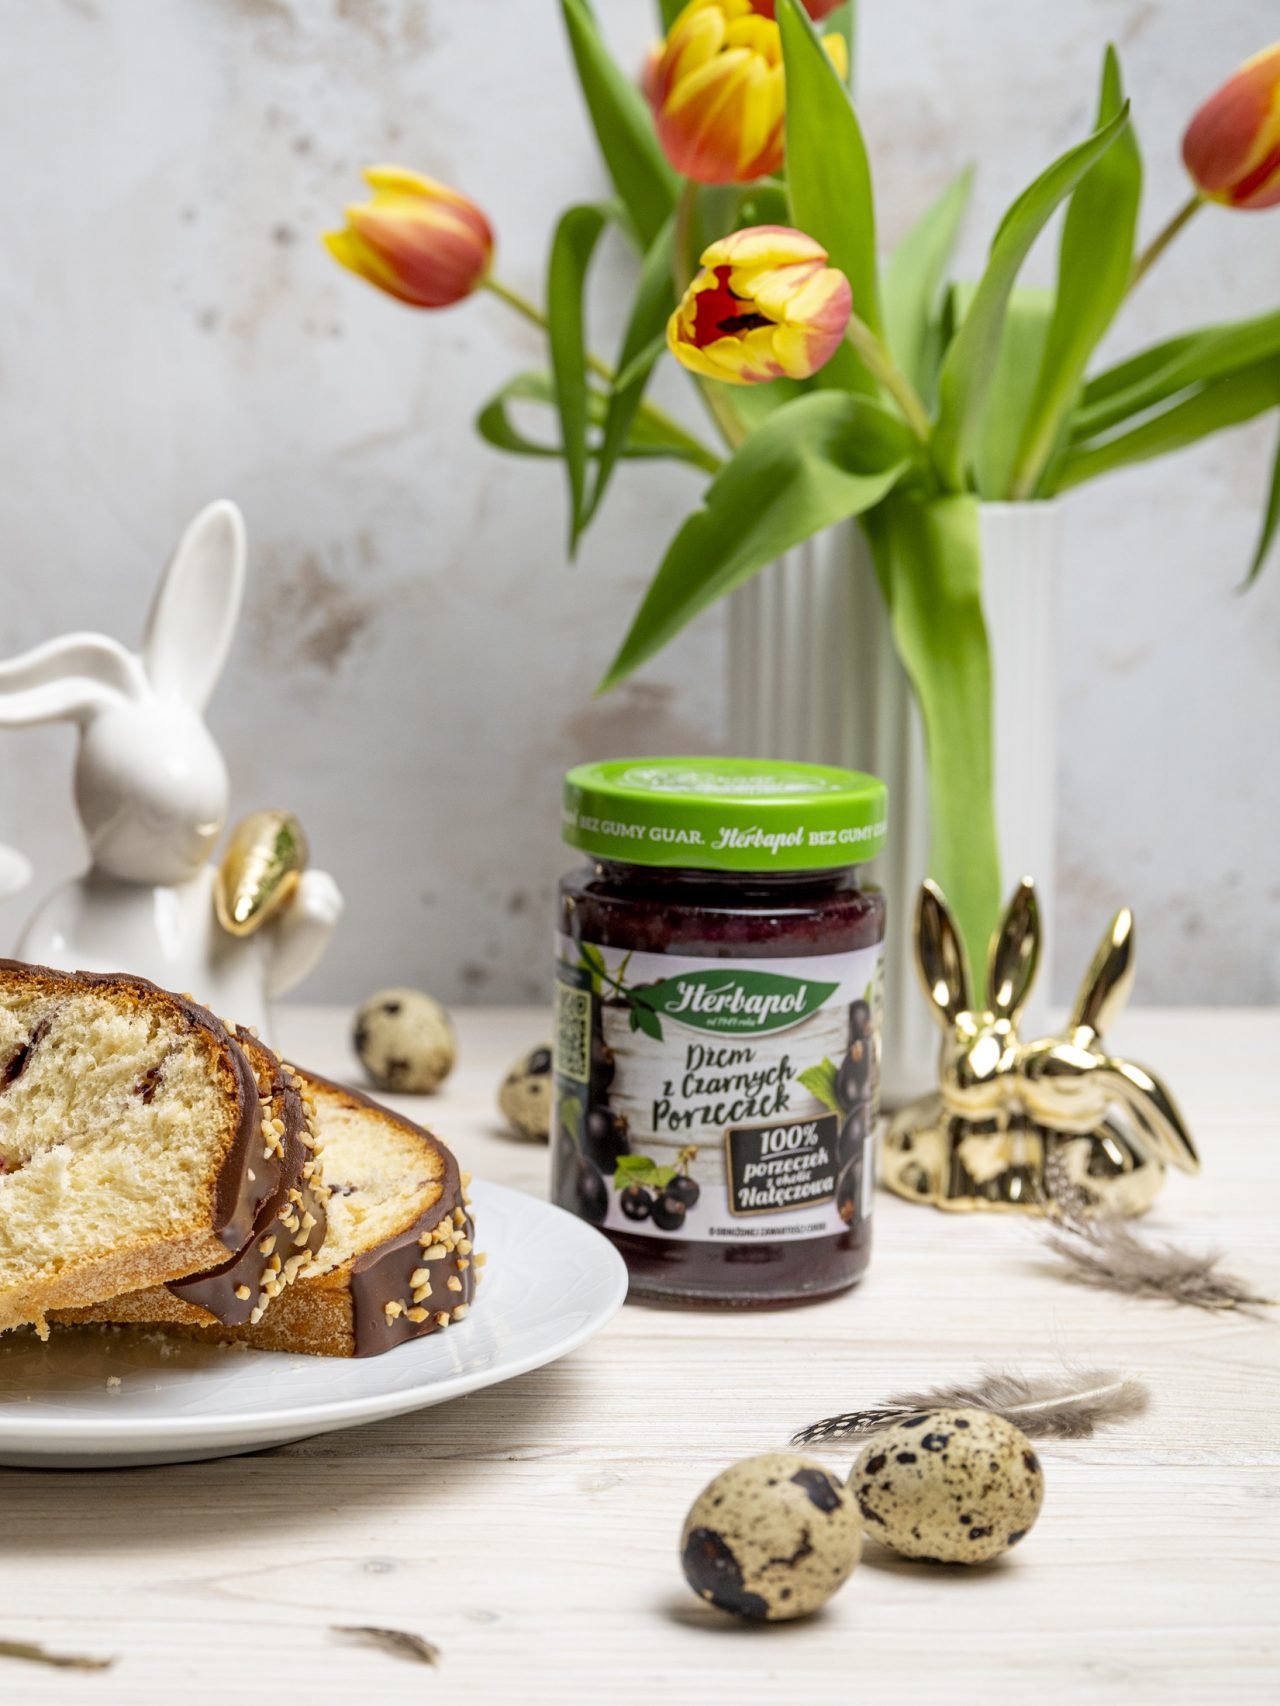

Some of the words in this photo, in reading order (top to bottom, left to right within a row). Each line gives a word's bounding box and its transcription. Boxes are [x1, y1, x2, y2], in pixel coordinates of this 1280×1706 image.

[601, 820, 646, 839] GUMY
[649, 827, 705, 845] GUAR.
[711, 825, 804, 855] Herbapol
[808, 830, 837, 846] BEZ
[664, 980, 807, 1025] Herbapol
[663, 1081, 674, 1096] z
[682, 1054, 797, 1098] Czarnych
[653, 1083, 790, 1132] Porzeczek
[761, 1122, 819, 1154] 100%
[743, 1147, 829, 1184] porzeczek
